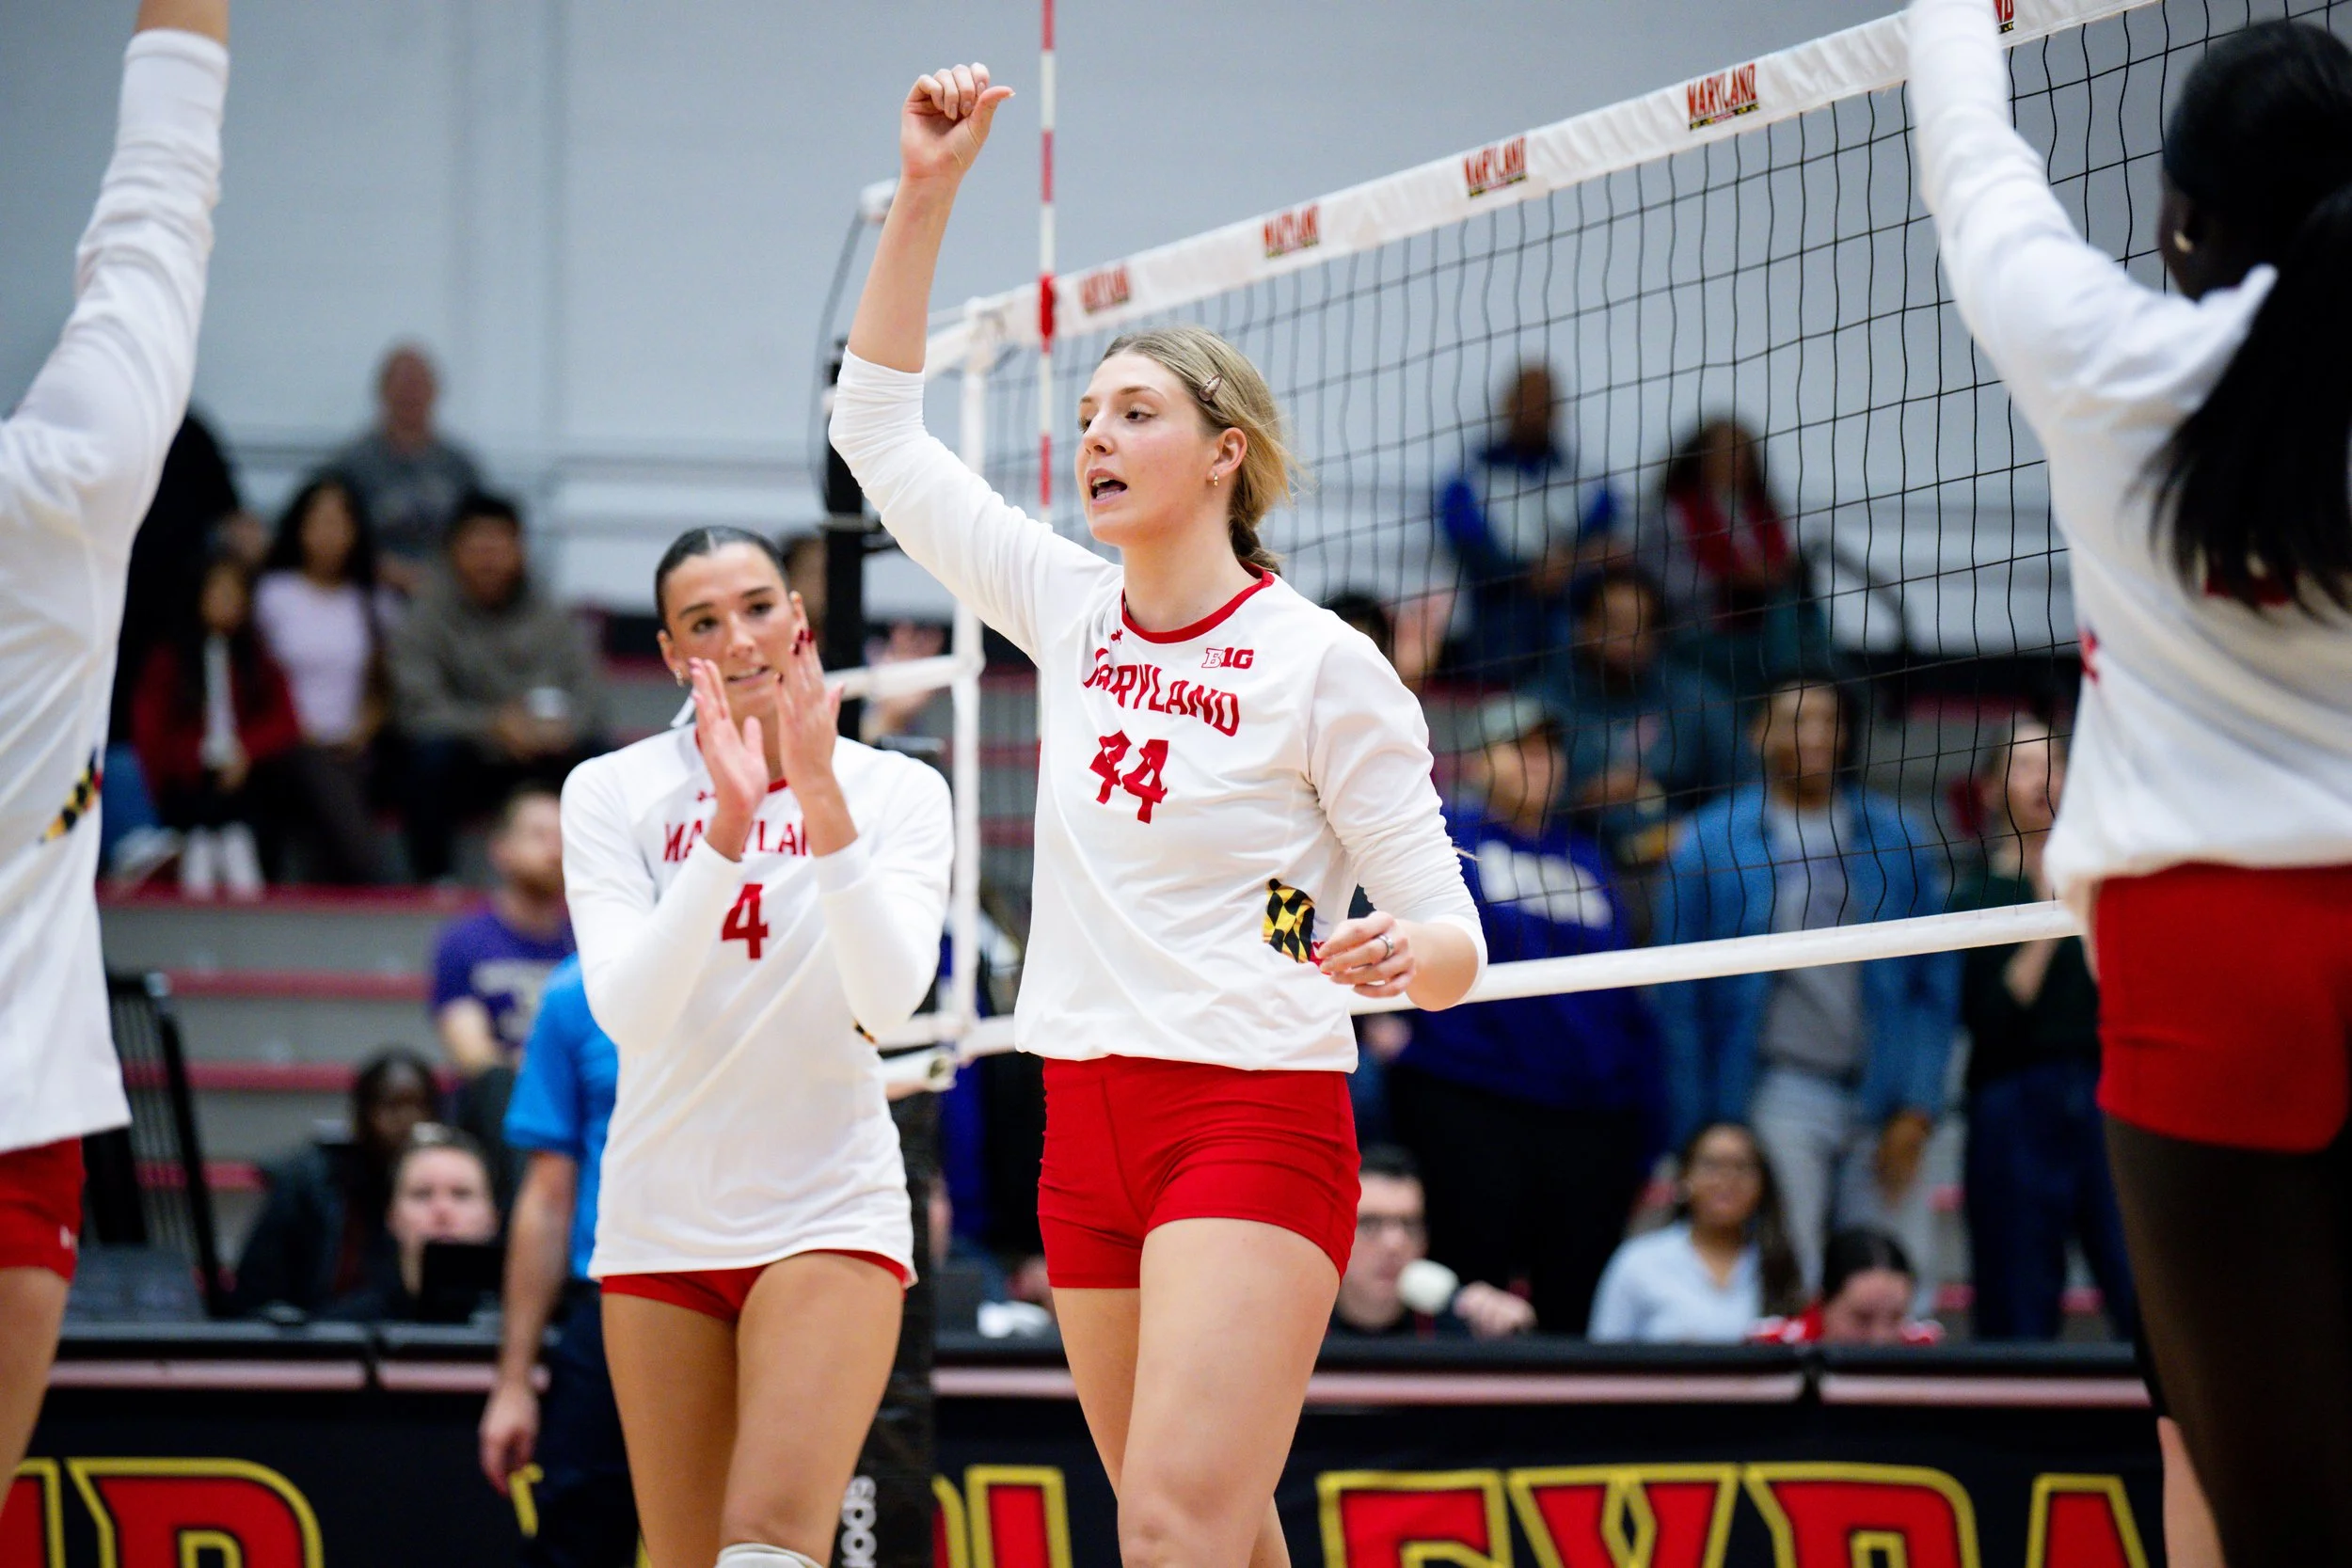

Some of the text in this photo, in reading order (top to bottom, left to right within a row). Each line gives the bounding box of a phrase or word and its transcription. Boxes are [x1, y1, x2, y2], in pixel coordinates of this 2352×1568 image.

[1687, 62, 1756, 120] MARYLAND
[1089, 730, 1169, 824] 44
[721, 883, 770, 960] 4
